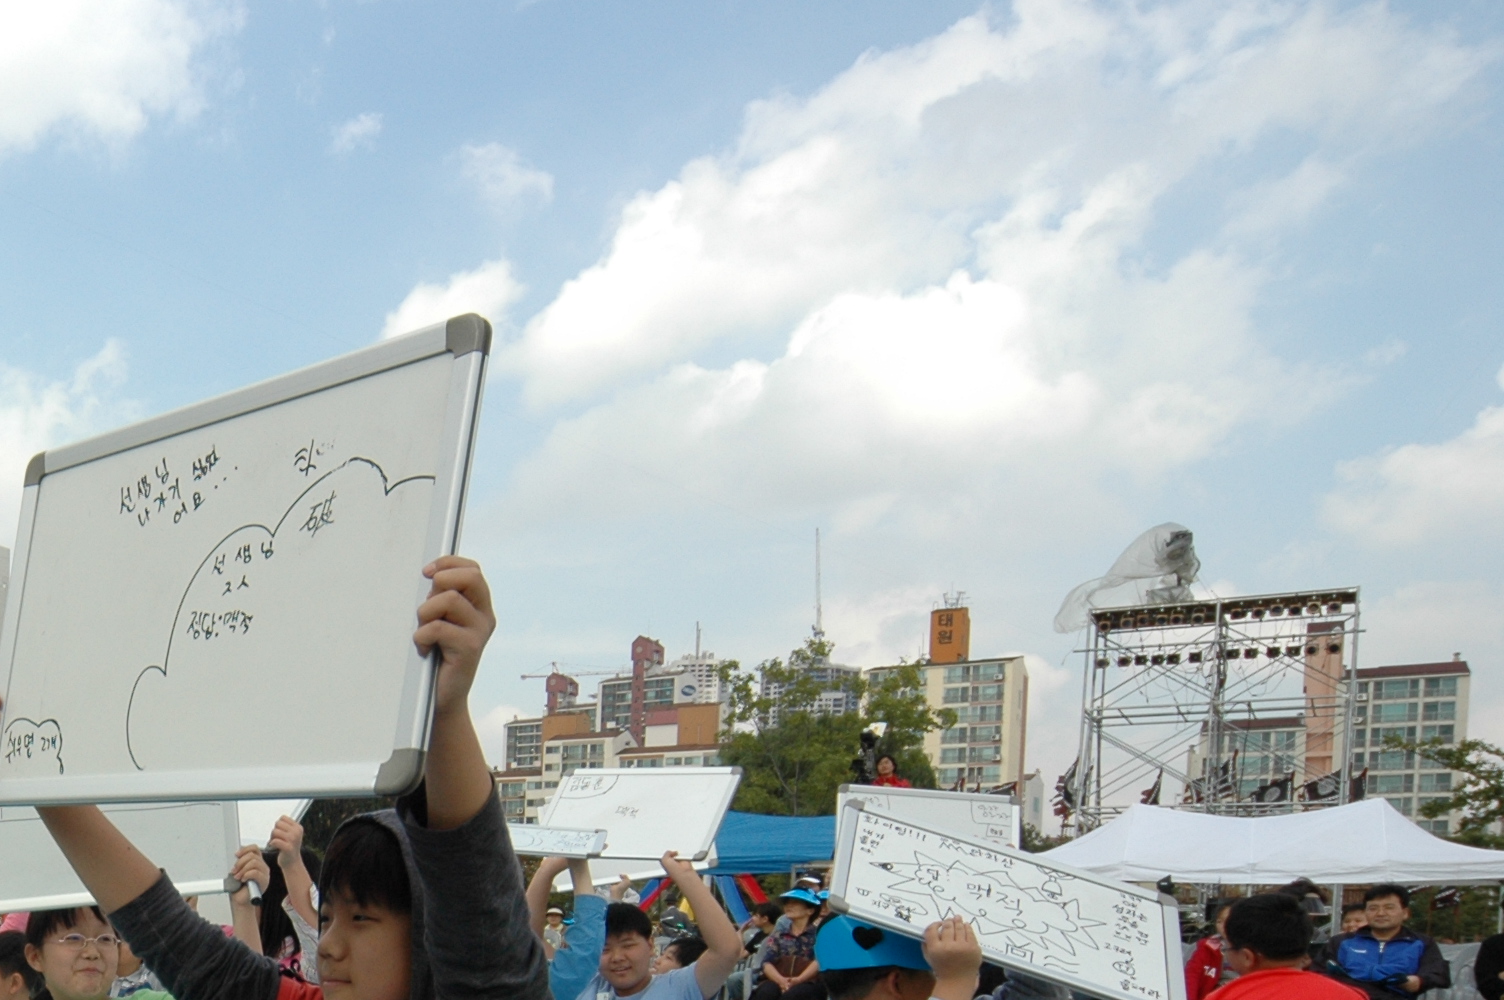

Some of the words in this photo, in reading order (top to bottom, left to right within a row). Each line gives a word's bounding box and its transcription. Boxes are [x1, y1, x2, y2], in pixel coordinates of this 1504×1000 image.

[120, 458, 169, 514] 선생님
[212, 541, 274, 574] 선생님
[966, 882, 1023, 916] 맥적
